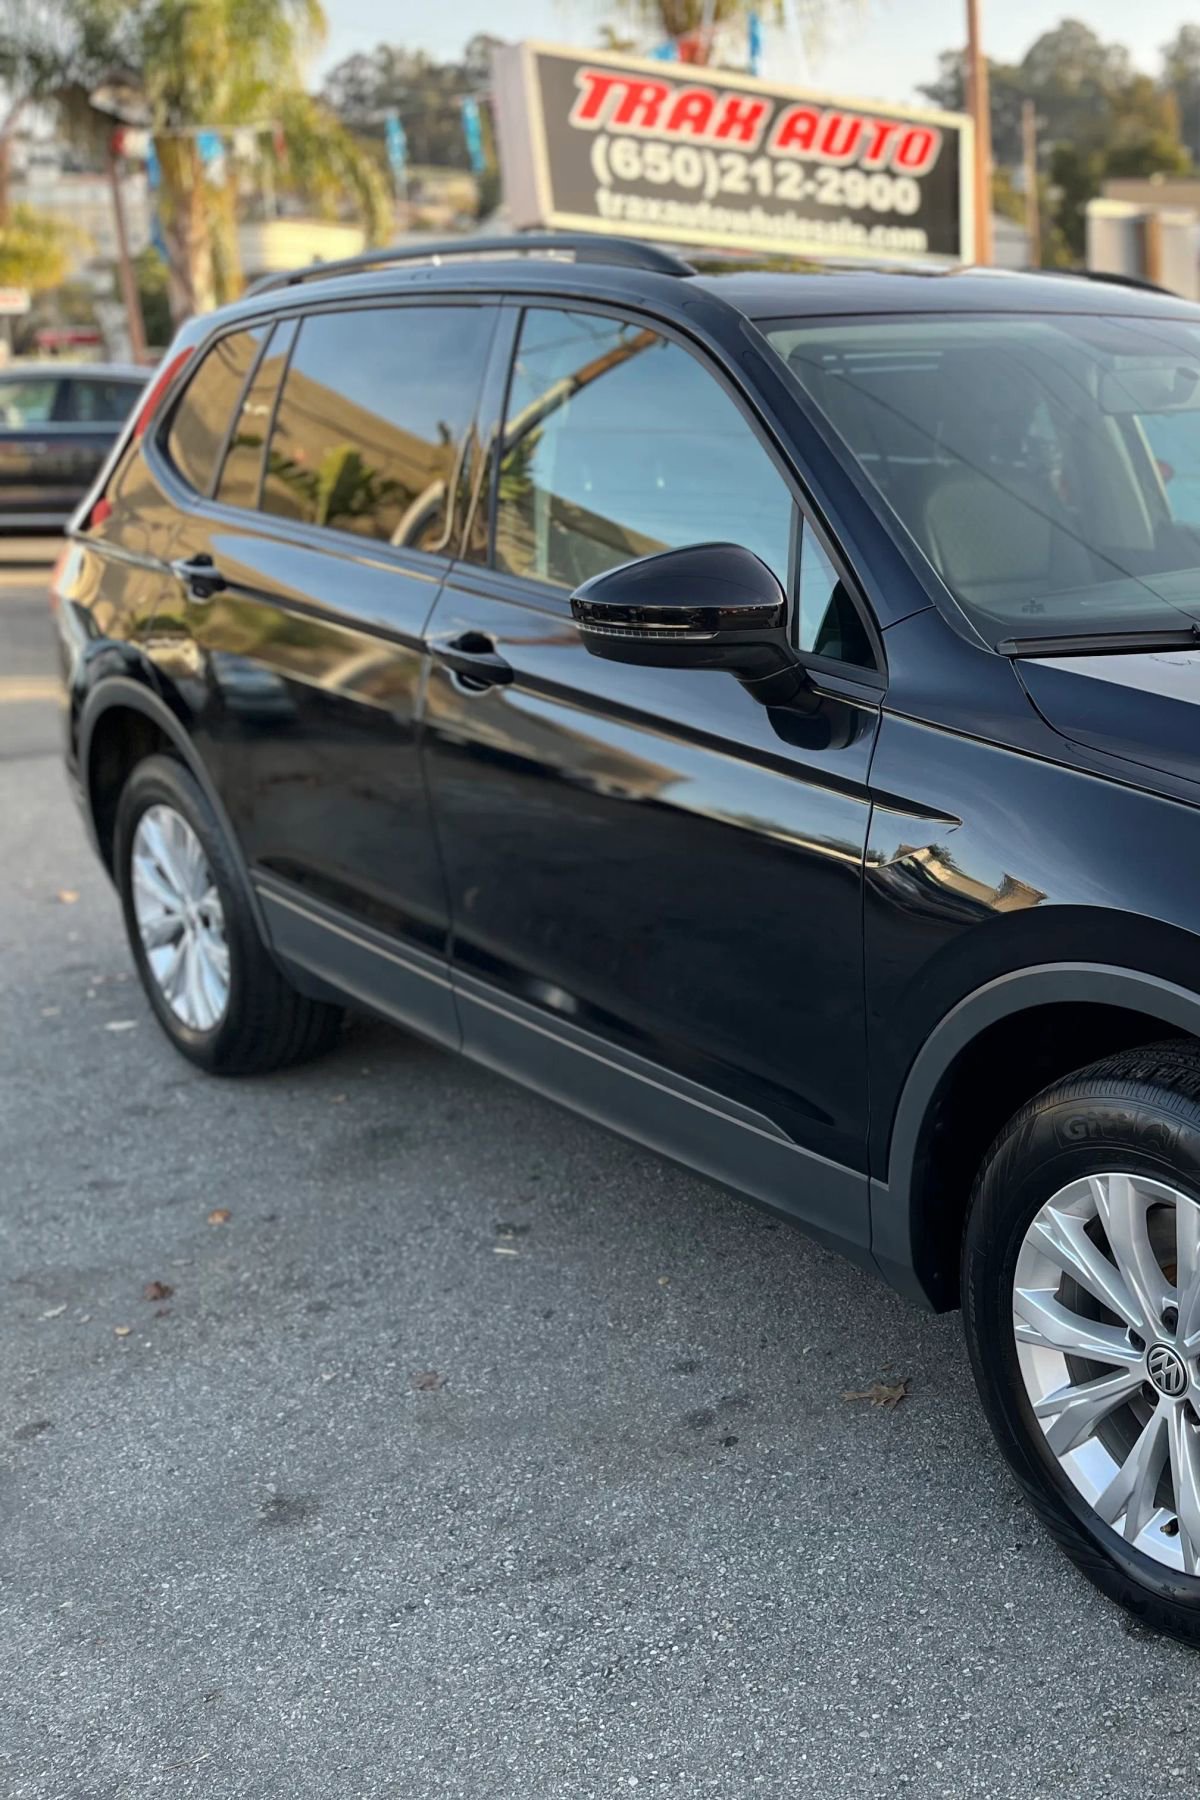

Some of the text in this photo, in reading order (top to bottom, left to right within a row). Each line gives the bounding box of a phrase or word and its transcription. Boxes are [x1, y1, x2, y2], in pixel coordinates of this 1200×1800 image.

[569, 69, 941, 174] TRAX AUTO
[591, 135, 921, 215] (650)212-2900
